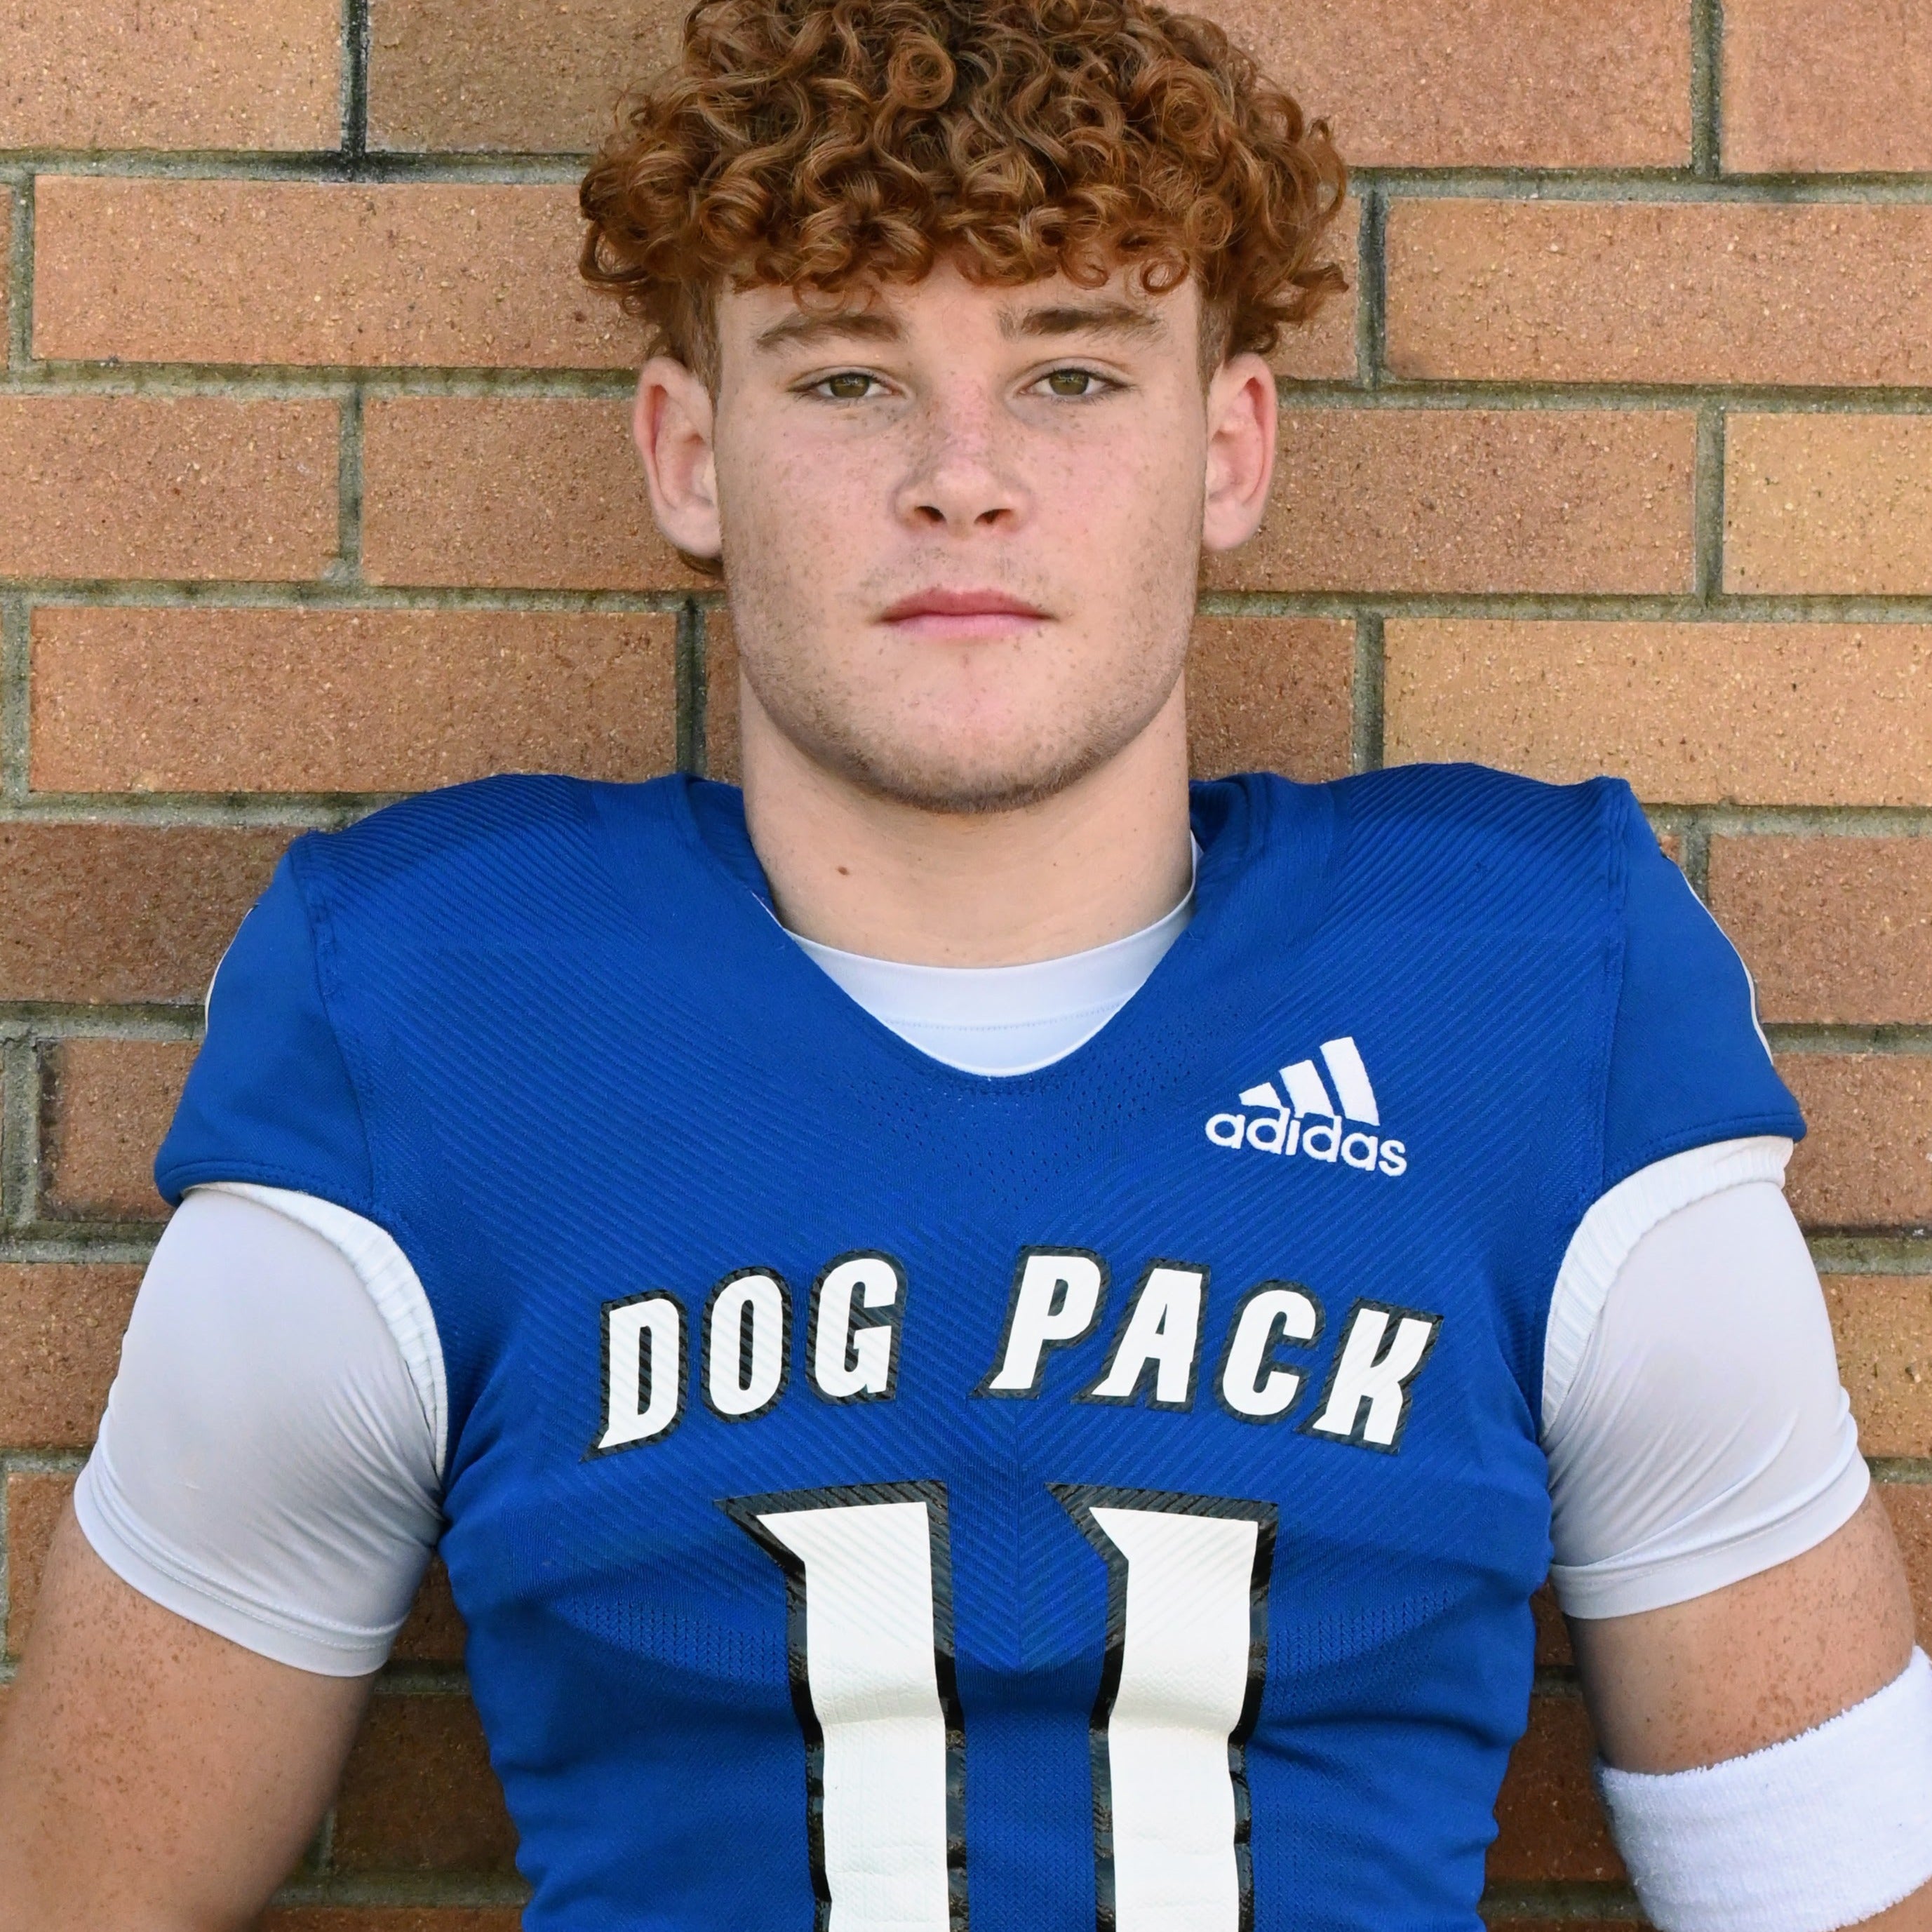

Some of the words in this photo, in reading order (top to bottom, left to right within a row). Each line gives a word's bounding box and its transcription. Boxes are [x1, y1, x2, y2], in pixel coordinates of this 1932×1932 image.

[1205, 1107, 1408, 1177] adidas
[584, 1252, 906, 1459] DOG
[974, 1247, 1441, 1452] PACK
[718, 1484, 1277, 1932] 11
